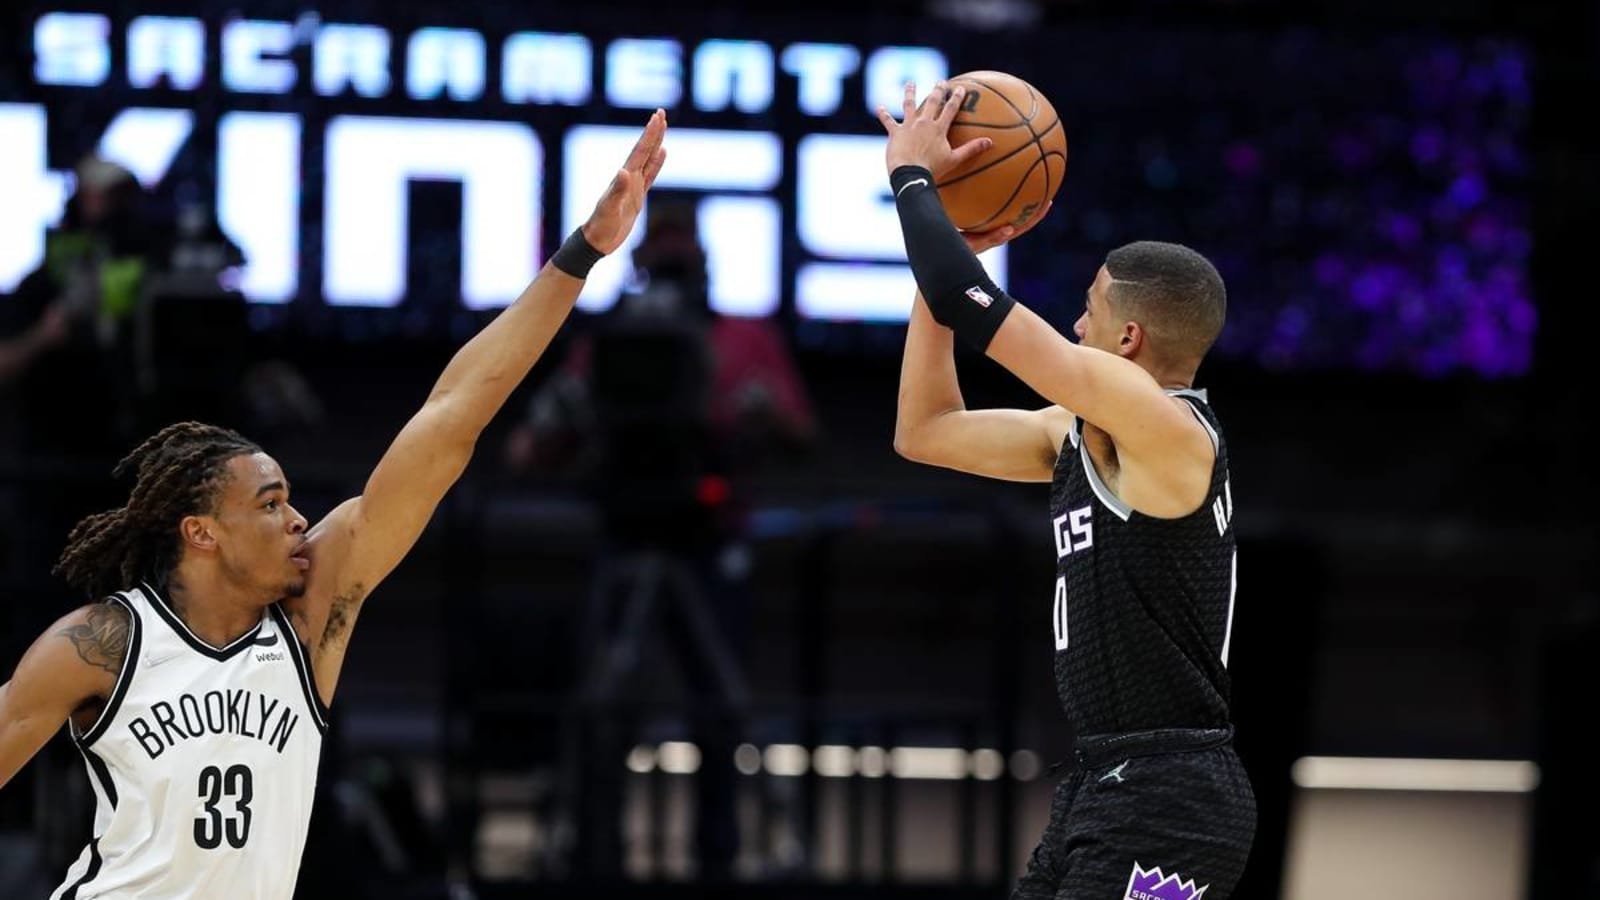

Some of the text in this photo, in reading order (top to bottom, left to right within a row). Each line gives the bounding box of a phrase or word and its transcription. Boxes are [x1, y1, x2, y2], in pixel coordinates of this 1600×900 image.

[33, 12, 948, 117] SACRAMENTO
[128, 689, 299, 760] BROOKLYN
[193, 764, 253, 849] 33
